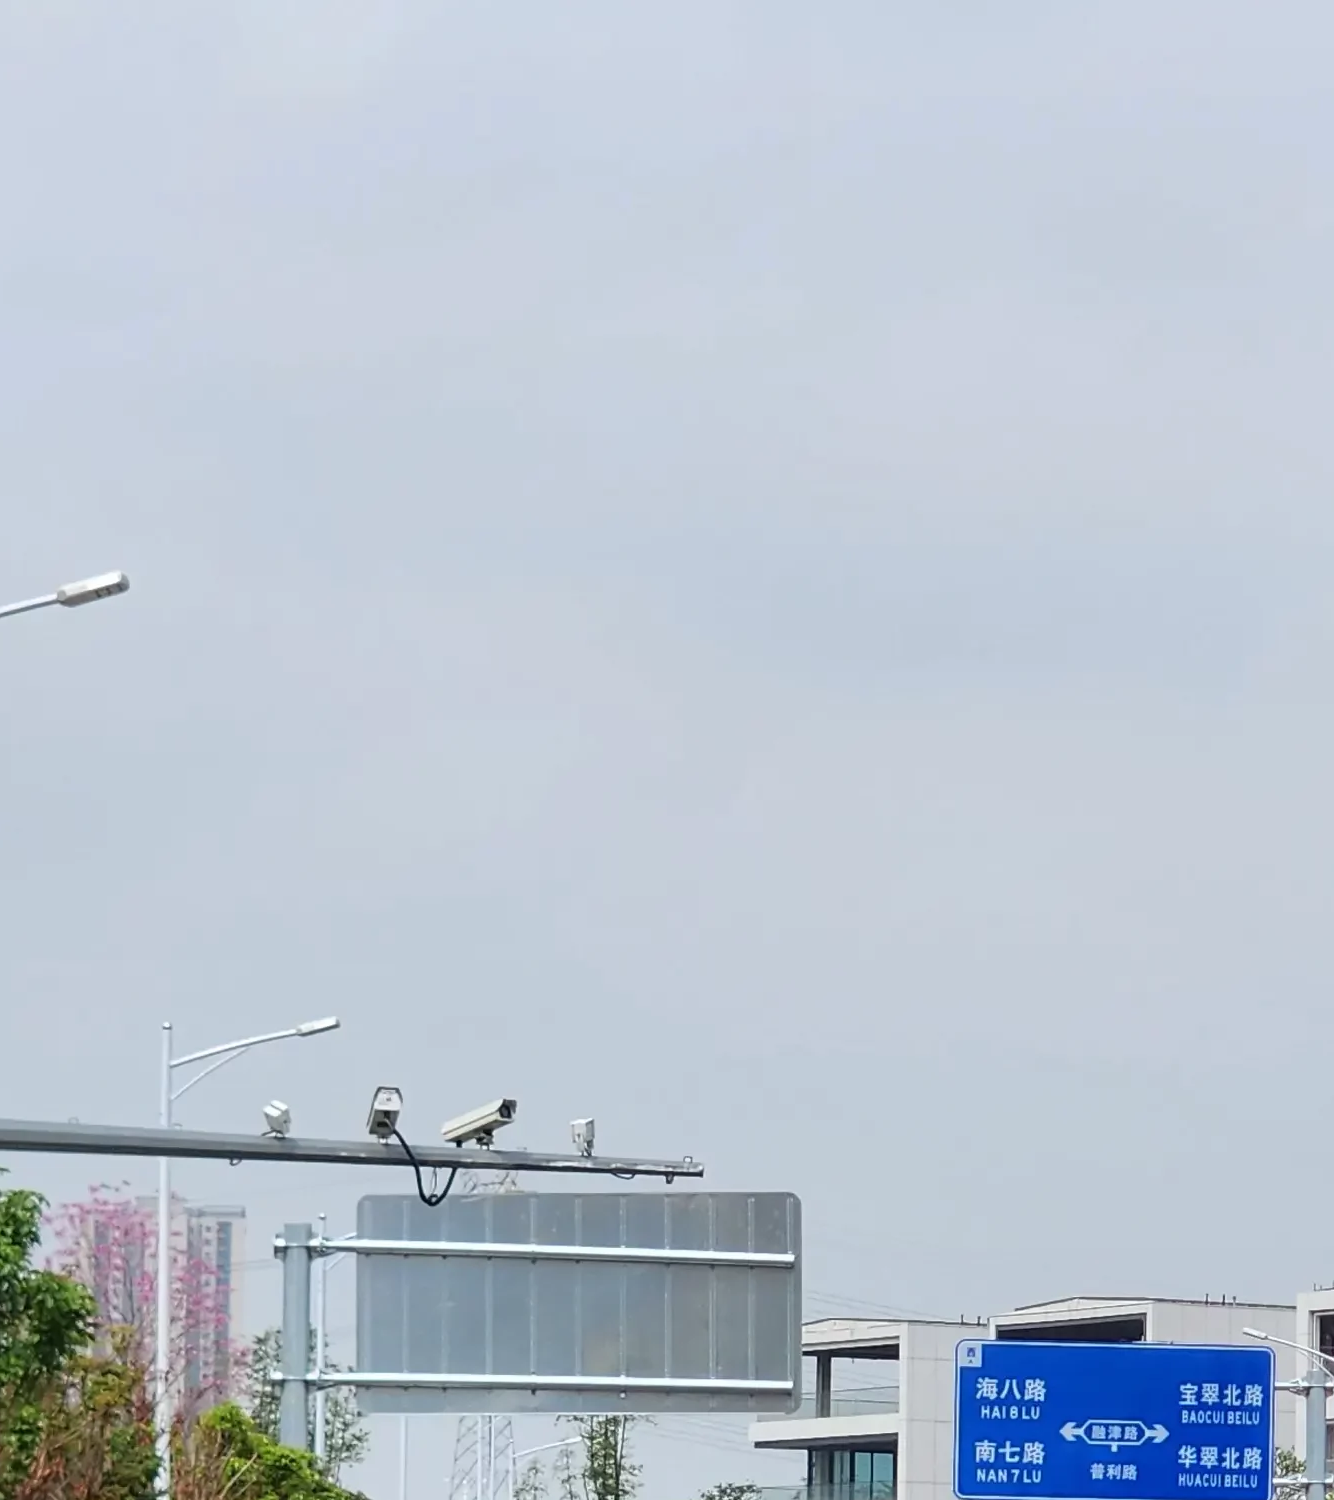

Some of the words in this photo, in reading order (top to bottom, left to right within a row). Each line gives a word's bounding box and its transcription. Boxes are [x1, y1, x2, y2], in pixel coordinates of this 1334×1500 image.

[975, 1377, 1046, 1401] 海八路
[1178, 1383, 1264, 1407] 宝翠北路
[980, 1405, 1007, 1420] HAI
[1009, 1405, 1019, 1420] 8
[1021, 1406, 1041, 1420] LU
[1181, 1409, 1225, 1424] BAOCUI
[1227, 1411, 1260, 1425] BEILU
[974, 1440, 1046, 1465] 南七路
[1177, 1444, 1263, 1470] 华翠北路
[976, 1468, 1008, 1483] NAN
[1010, 1468, 1021, 1483] 7
[1022, 1469, 1042, 1484] LU
[1090, 1462, 1138, 1481] 普利路
[1178, 1473, 1222, 1488] HUACUI
[1224, 1474, 1258, 1489] BEILU
